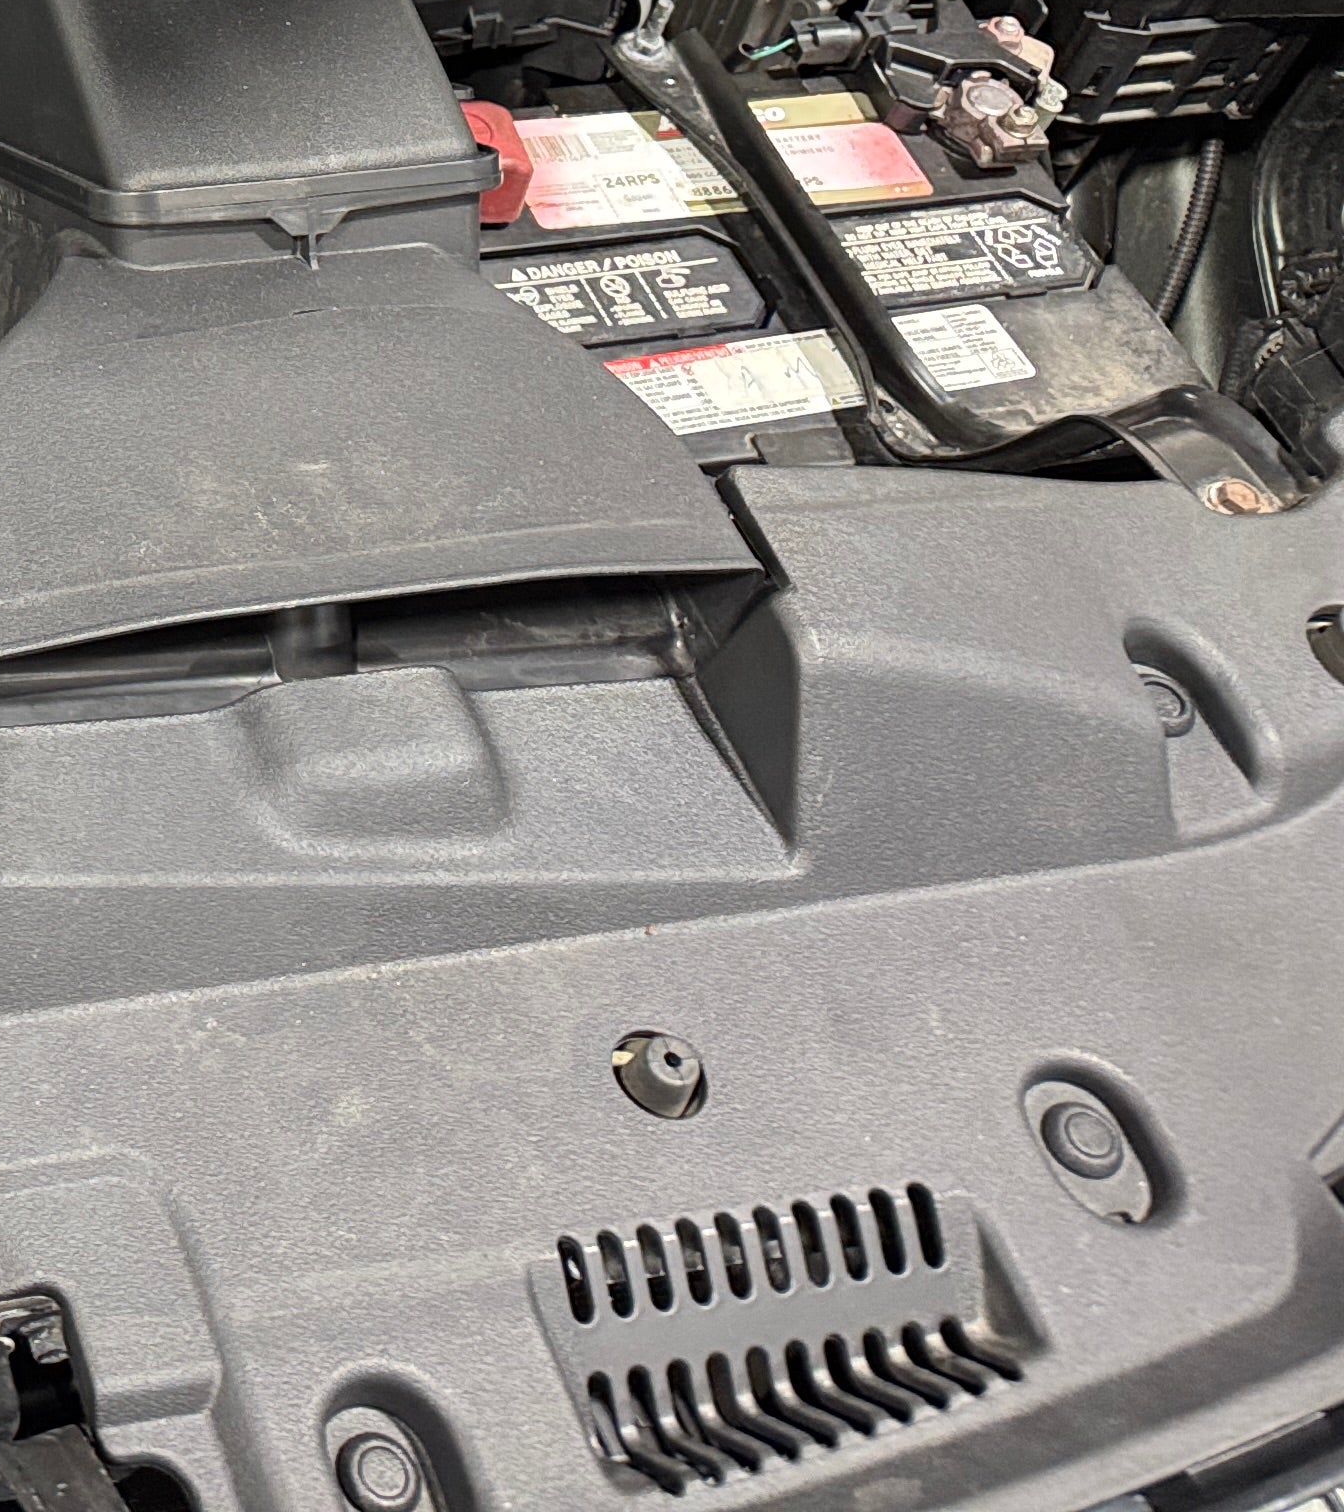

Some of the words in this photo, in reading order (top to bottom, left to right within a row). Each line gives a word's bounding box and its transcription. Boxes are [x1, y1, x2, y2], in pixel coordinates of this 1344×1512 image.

[602, 173, 661, 189] 24RPS
[526, 259, 602, 280] DANGER
[613, 249, 682, 270] POISON
